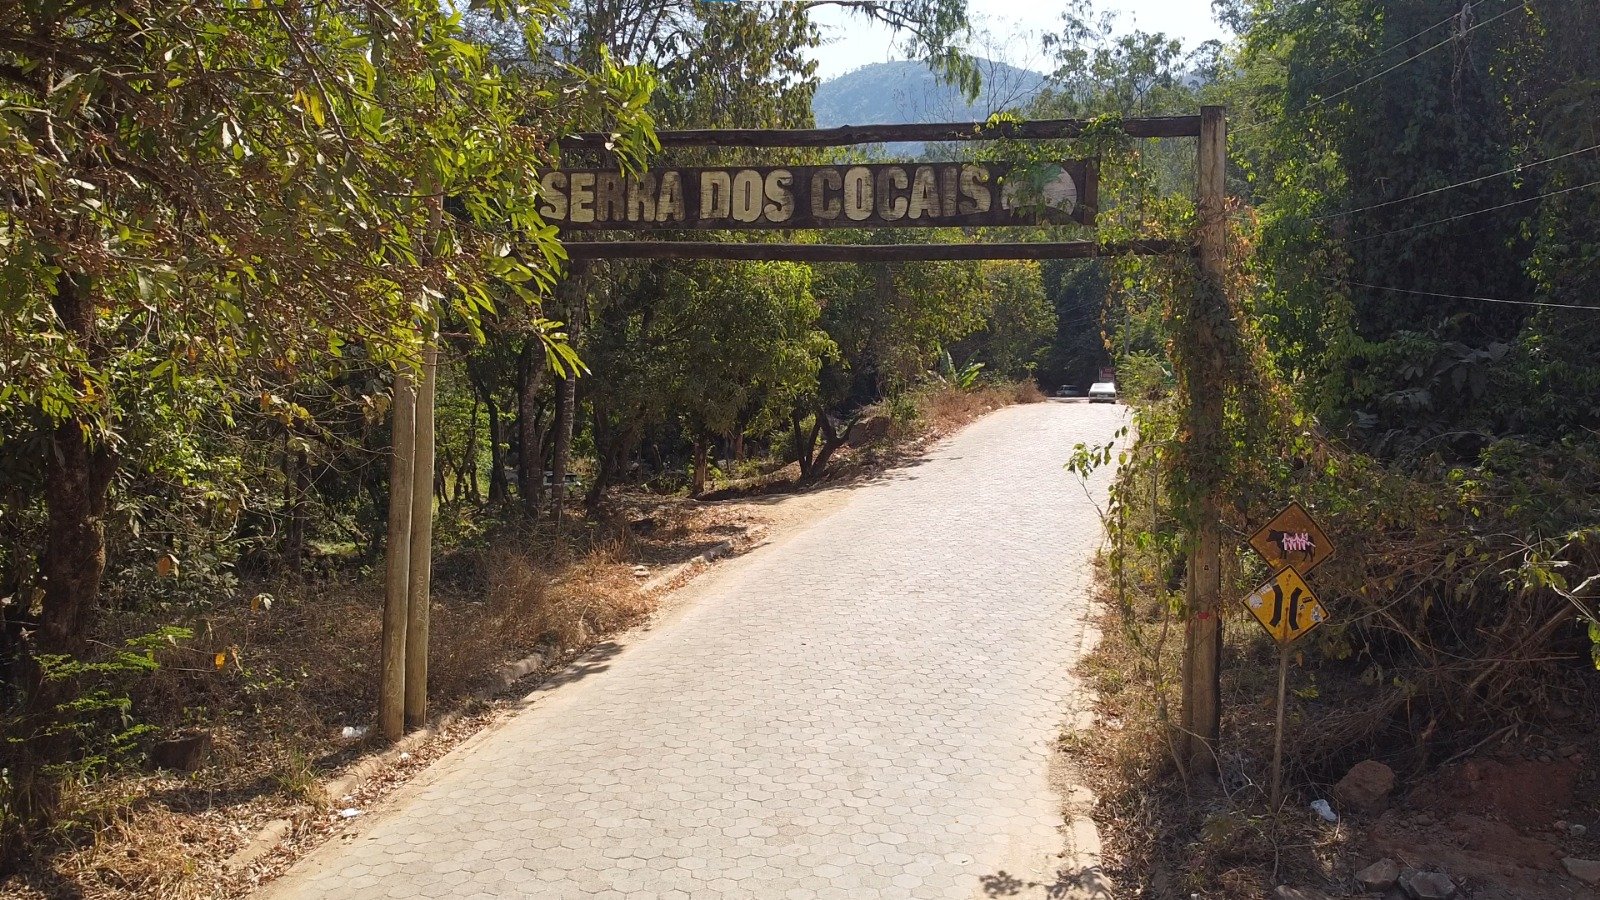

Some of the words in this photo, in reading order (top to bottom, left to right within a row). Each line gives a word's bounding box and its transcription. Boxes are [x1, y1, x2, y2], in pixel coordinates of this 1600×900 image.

[539, 171, 686, 222] SERRA
[700, 169, 794, 222] DOS
[811, 165, 991, 221] COCAIS
